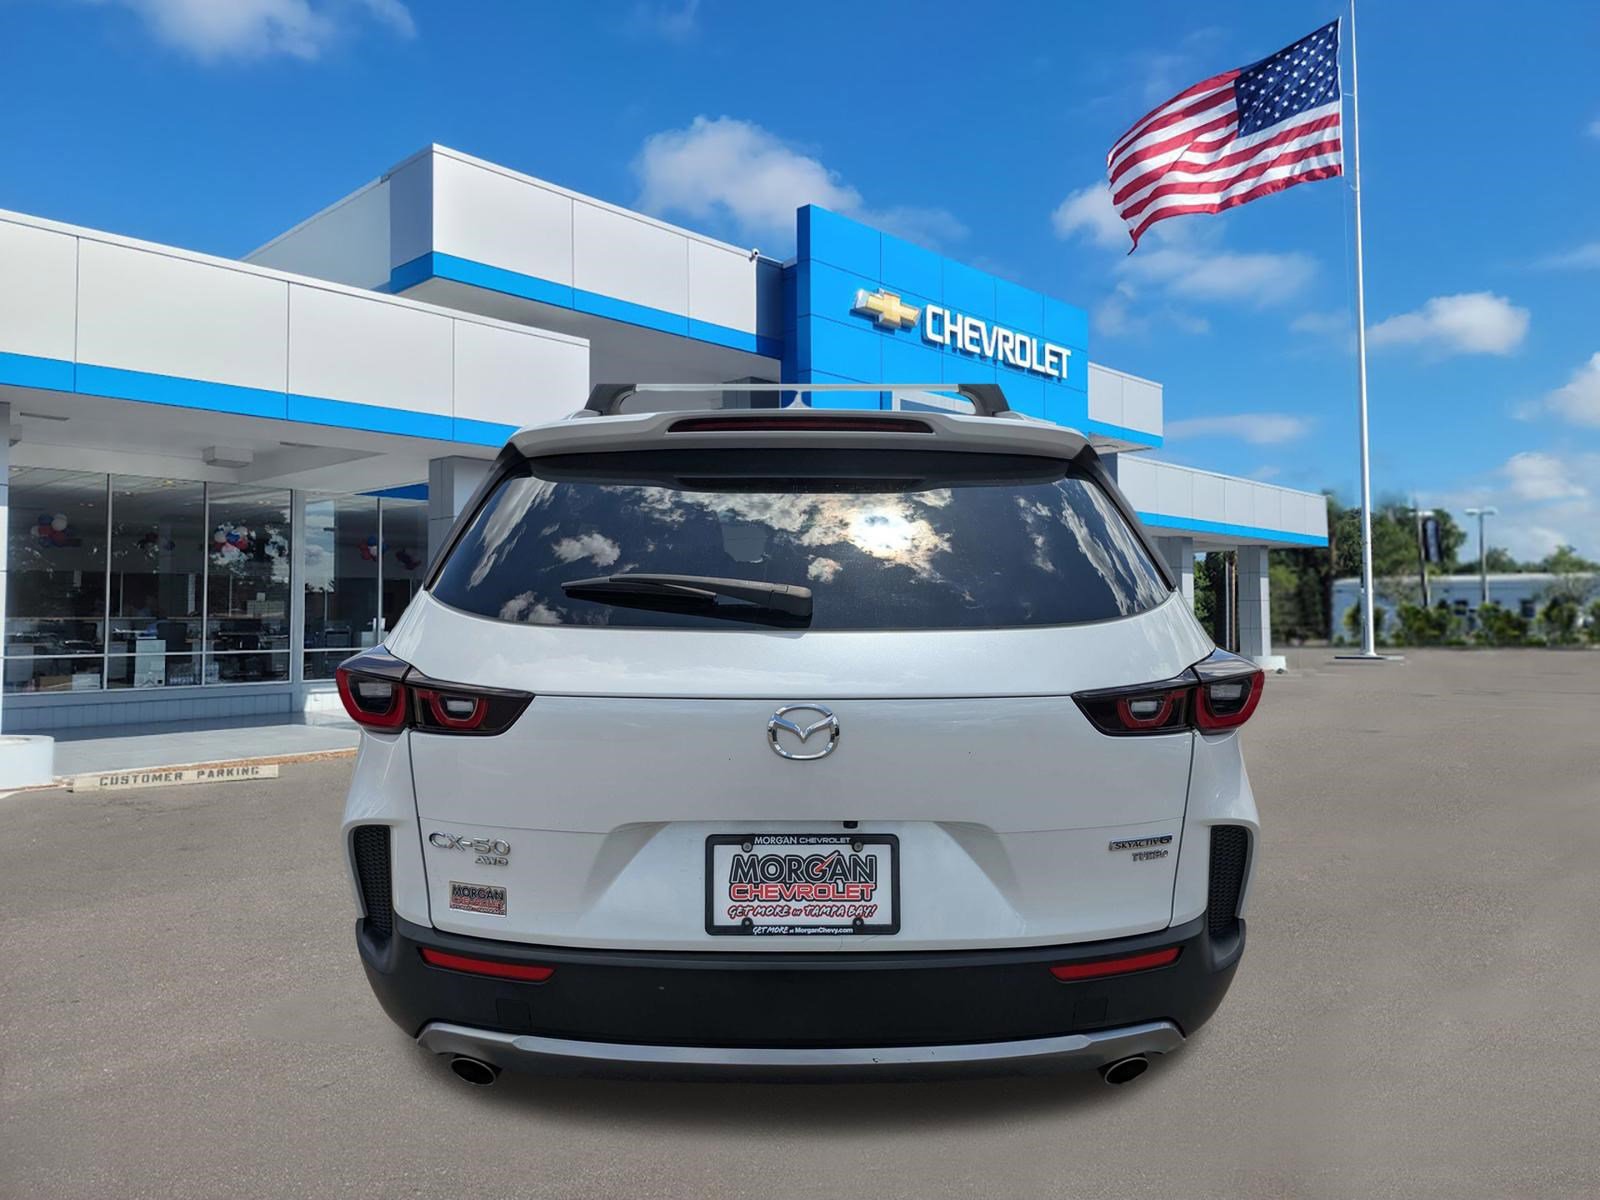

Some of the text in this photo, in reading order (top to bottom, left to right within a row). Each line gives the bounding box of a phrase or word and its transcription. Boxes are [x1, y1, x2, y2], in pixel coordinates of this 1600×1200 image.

[924, 304, 1072, 379] CHEVROLET
[99, 766, 260, 787] CUSTOMER PARKING
[429, 832, 511, 856] CX-50
[754, 836, 798, 844] MORGAN
[475, 855, 509, 866] AWD
[730, 851, 877, 884] MORGAN
[451, 884, 504, 900] MORGAN
[730, 883, 876, 901] CHEVROLET
[728, 904, 753, 918] GET
[753, 904, 791, 918] MORE
[804, 904, 845, 918] TAMPA
[846, 904, 878, 918] BAY!
[752, 926, 768, 935] GET
[767, 926, 789, 934] MORE
[795, 926, 854, 935] MorganChevy.com
